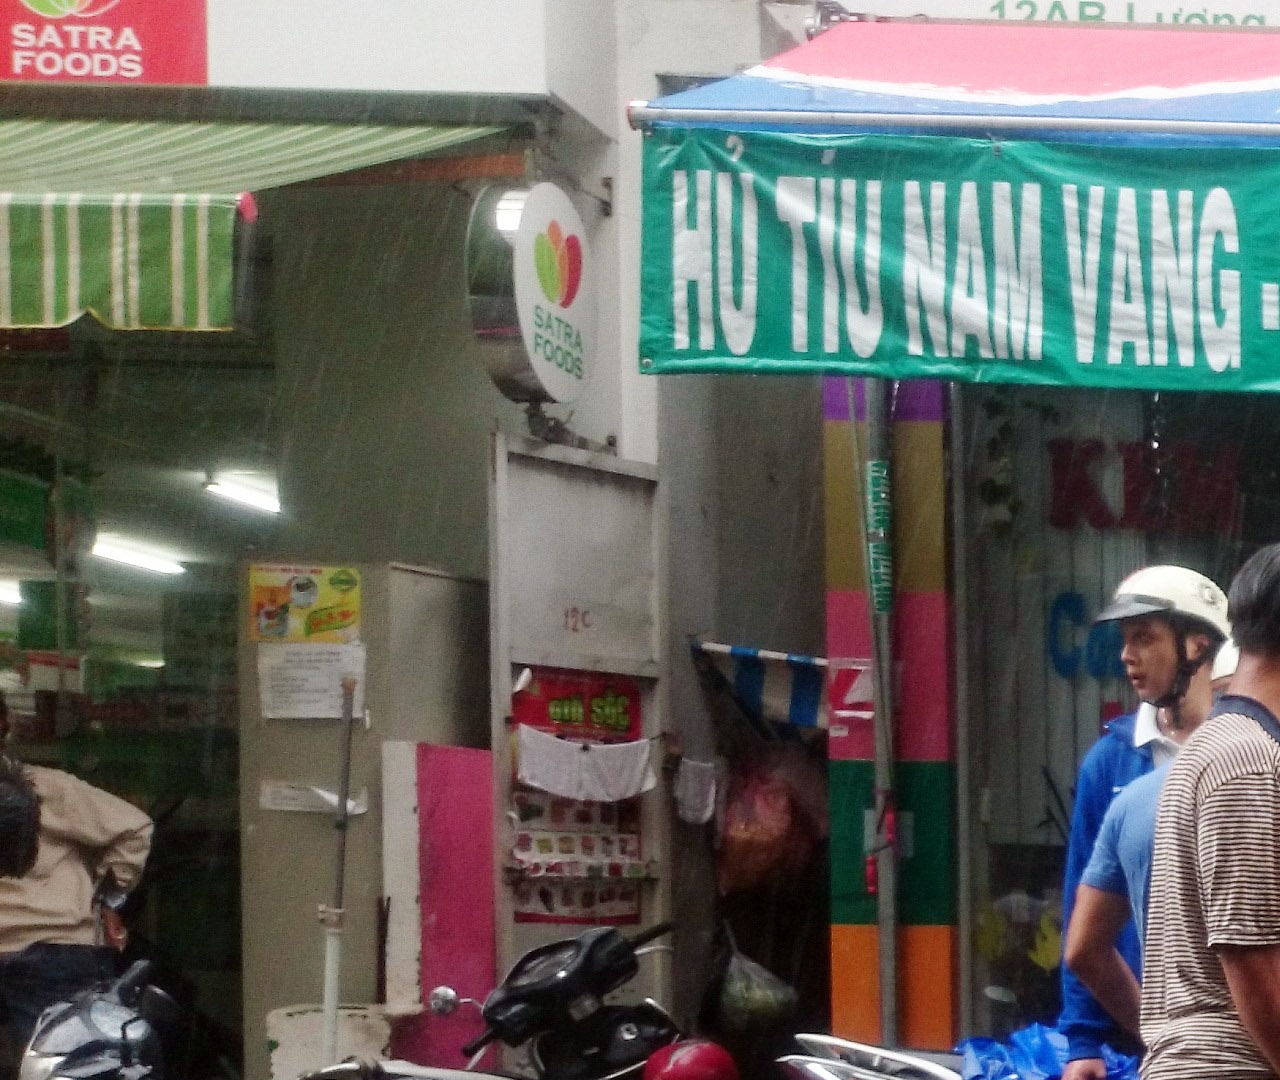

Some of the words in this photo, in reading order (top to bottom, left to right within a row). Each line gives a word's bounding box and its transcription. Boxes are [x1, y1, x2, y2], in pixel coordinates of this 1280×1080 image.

[11, 22, 142, 50] SATRA
[12, 49, 144, 78] FOODS
[672, 135, 759, 357] HỦ
[904, 179, 1043, 361] NAM
[1062, 184, 1242, 372] VANG
[533, 304, 583, 354] SATRA
[533, 331, 583, 381] FOODS
